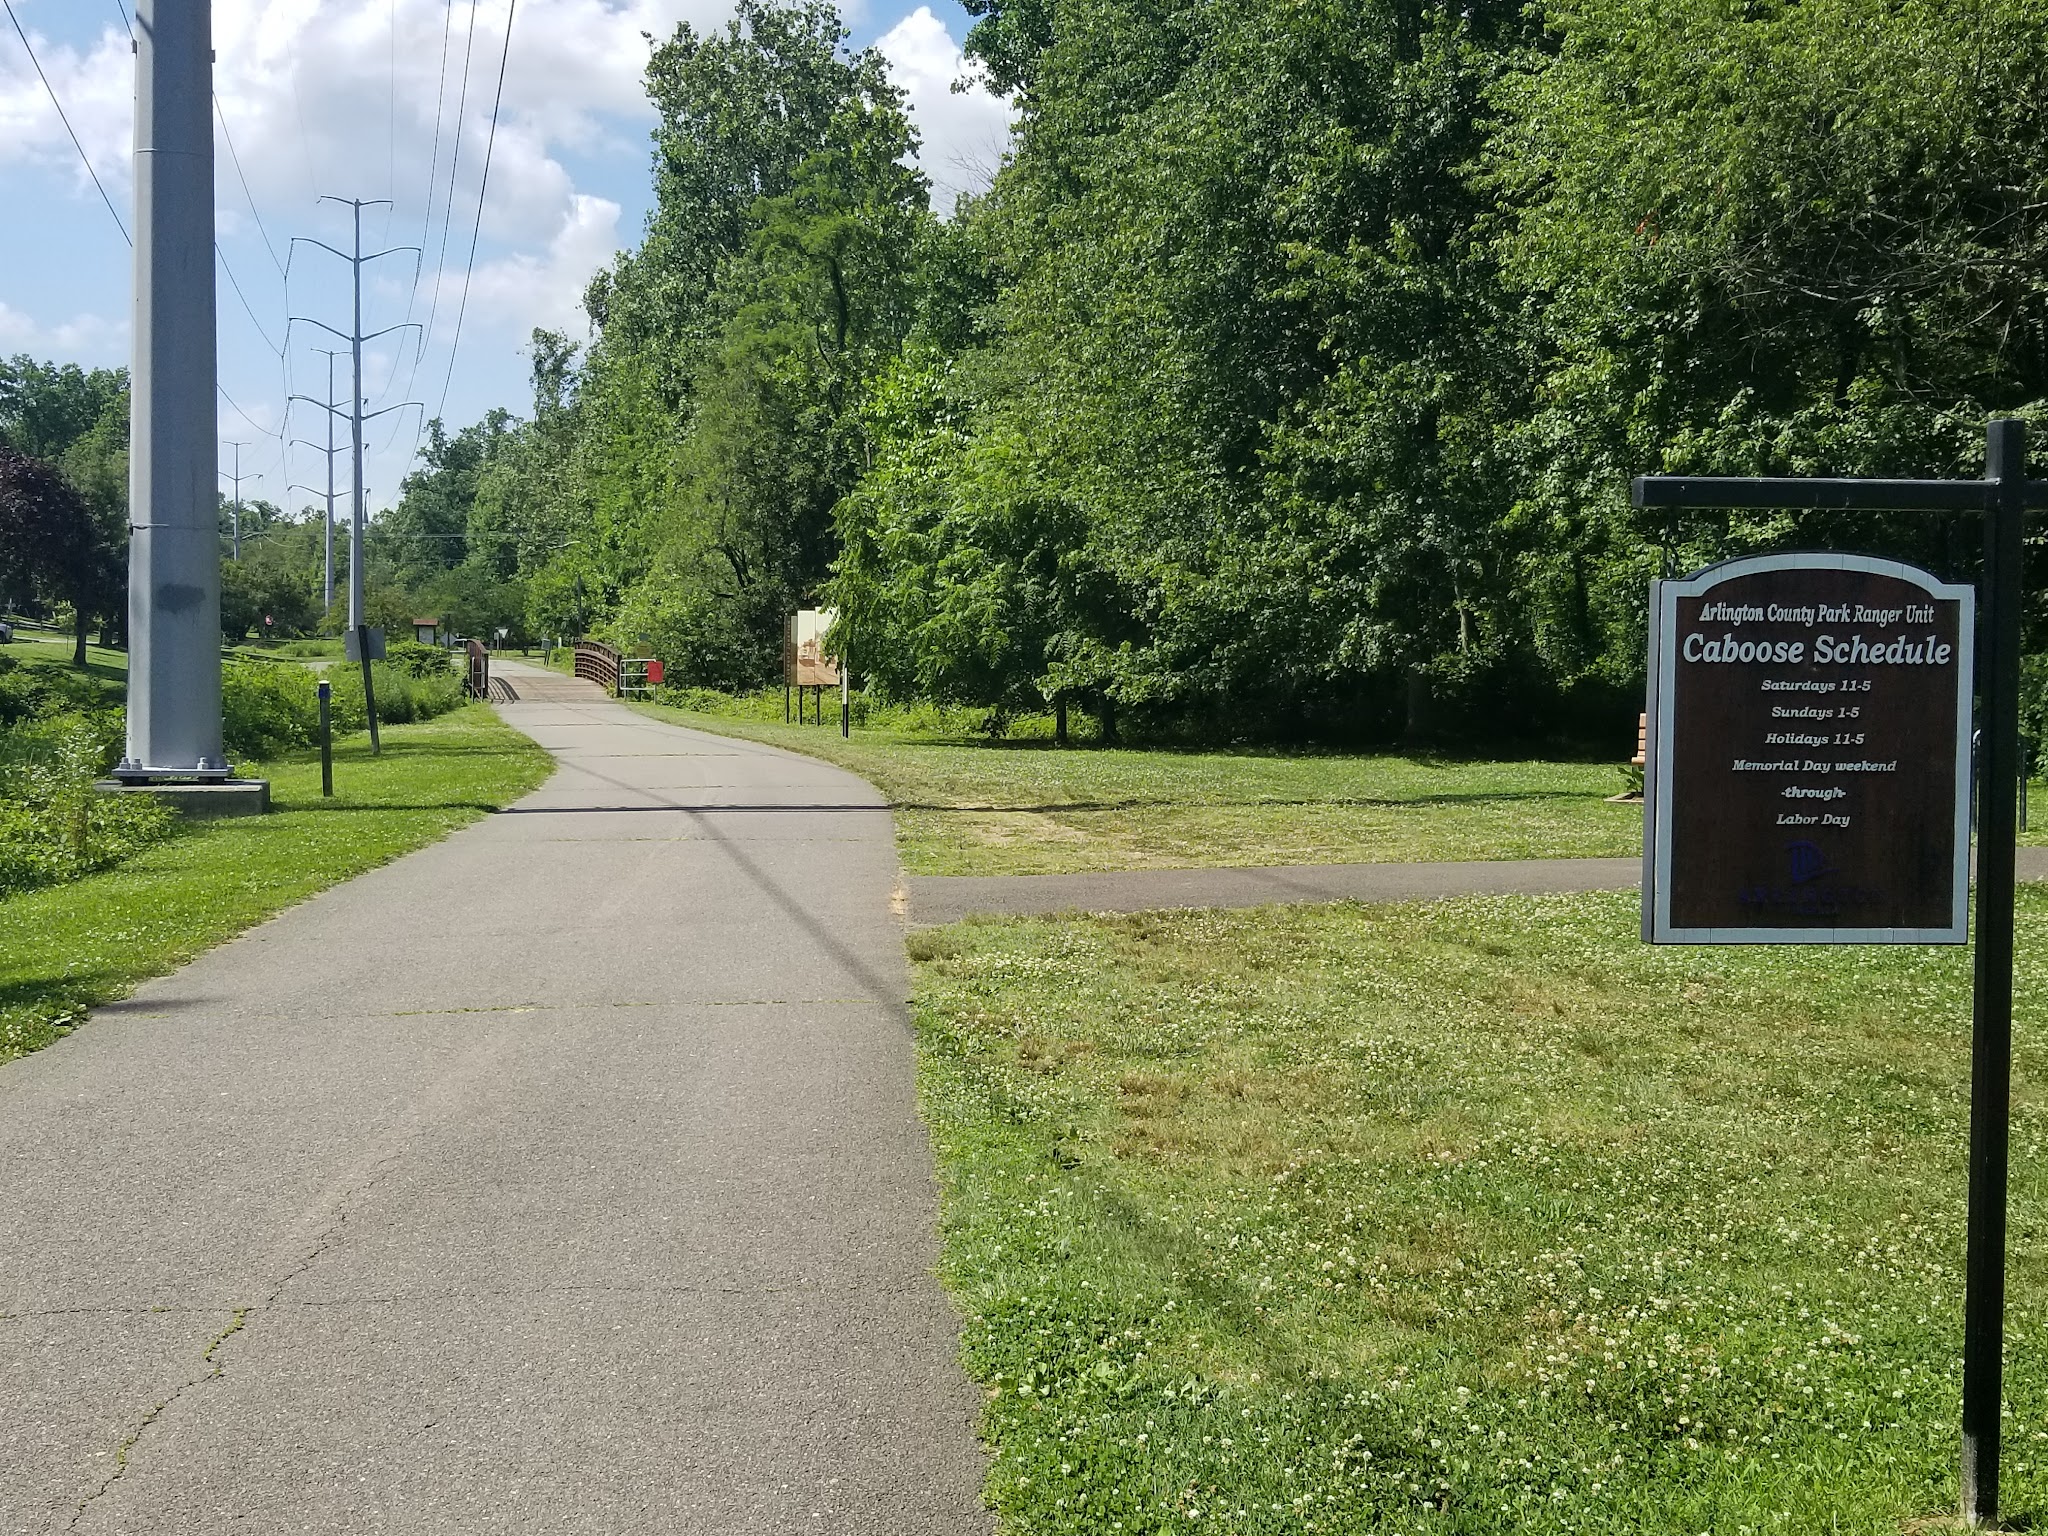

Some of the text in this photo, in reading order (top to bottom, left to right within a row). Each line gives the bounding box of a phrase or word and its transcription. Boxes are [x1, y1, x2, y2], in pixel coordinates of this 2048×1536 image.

[1699, 602, 1934, 628] Arlington County Park Ranger Unit
[1683, 632, 1951, 665] Caboose Schedule
[1761, 680, 1872, 694] Saturdays 11-5
[1771, 706, 1860, 720] Sundays 1-5
[1765, 733, 1865, 747] Holidays 11-5
[1732, 759, 1897, 774] Memorial Day weekend
[1776, 813, 1851, 828] Labor Day
